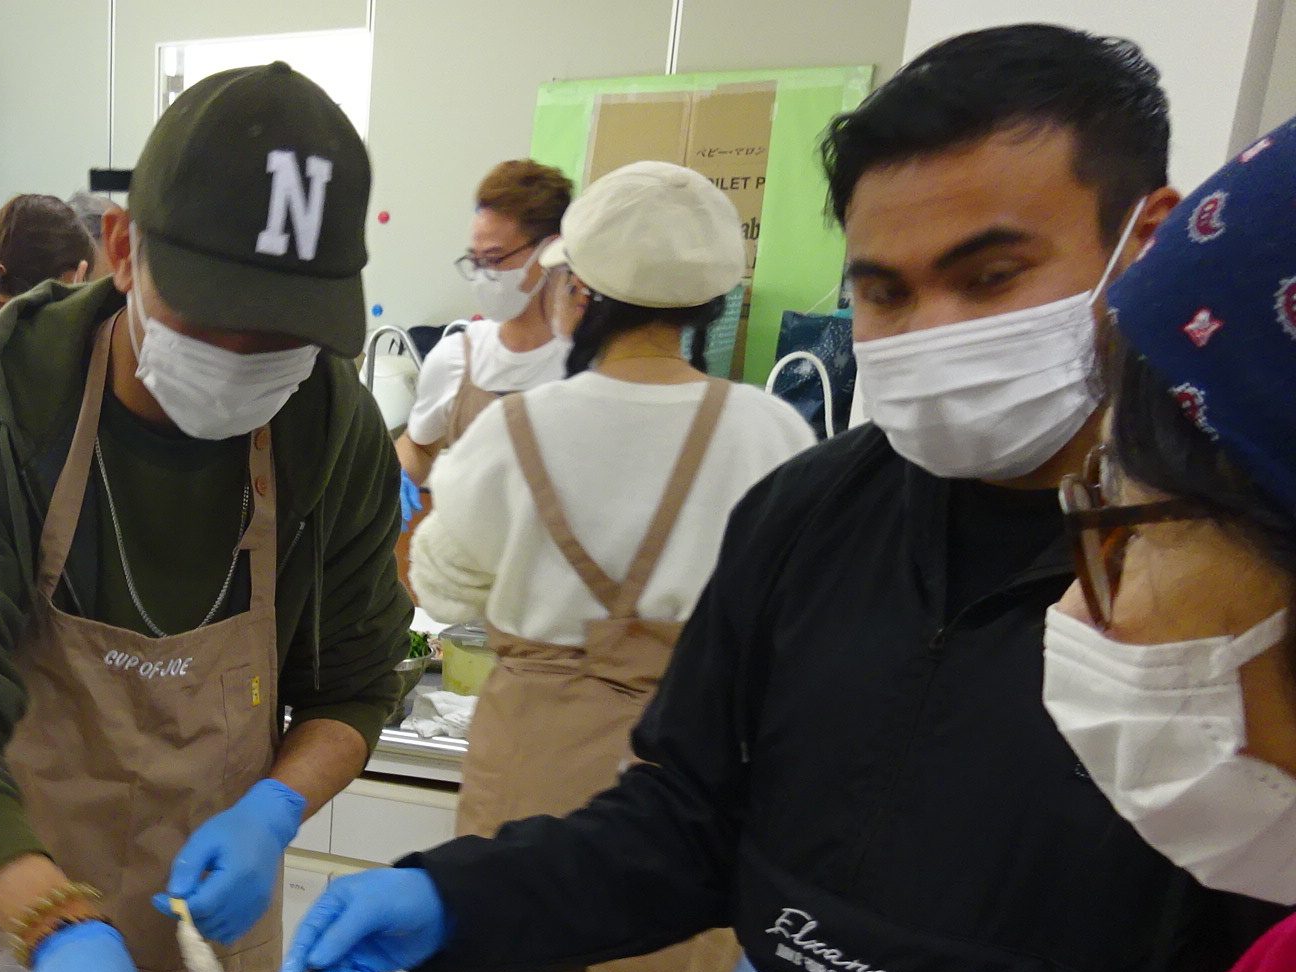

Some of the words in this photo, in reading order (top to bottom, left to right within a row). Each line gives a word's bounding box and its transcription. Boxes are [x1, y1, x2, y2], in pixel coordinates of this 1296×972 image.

[255, 149, 333, 261] N
[104, 649, 140, 670] CUP
[139, 660, 164, 680] OF
[160, 656, 194, 678] JOE
